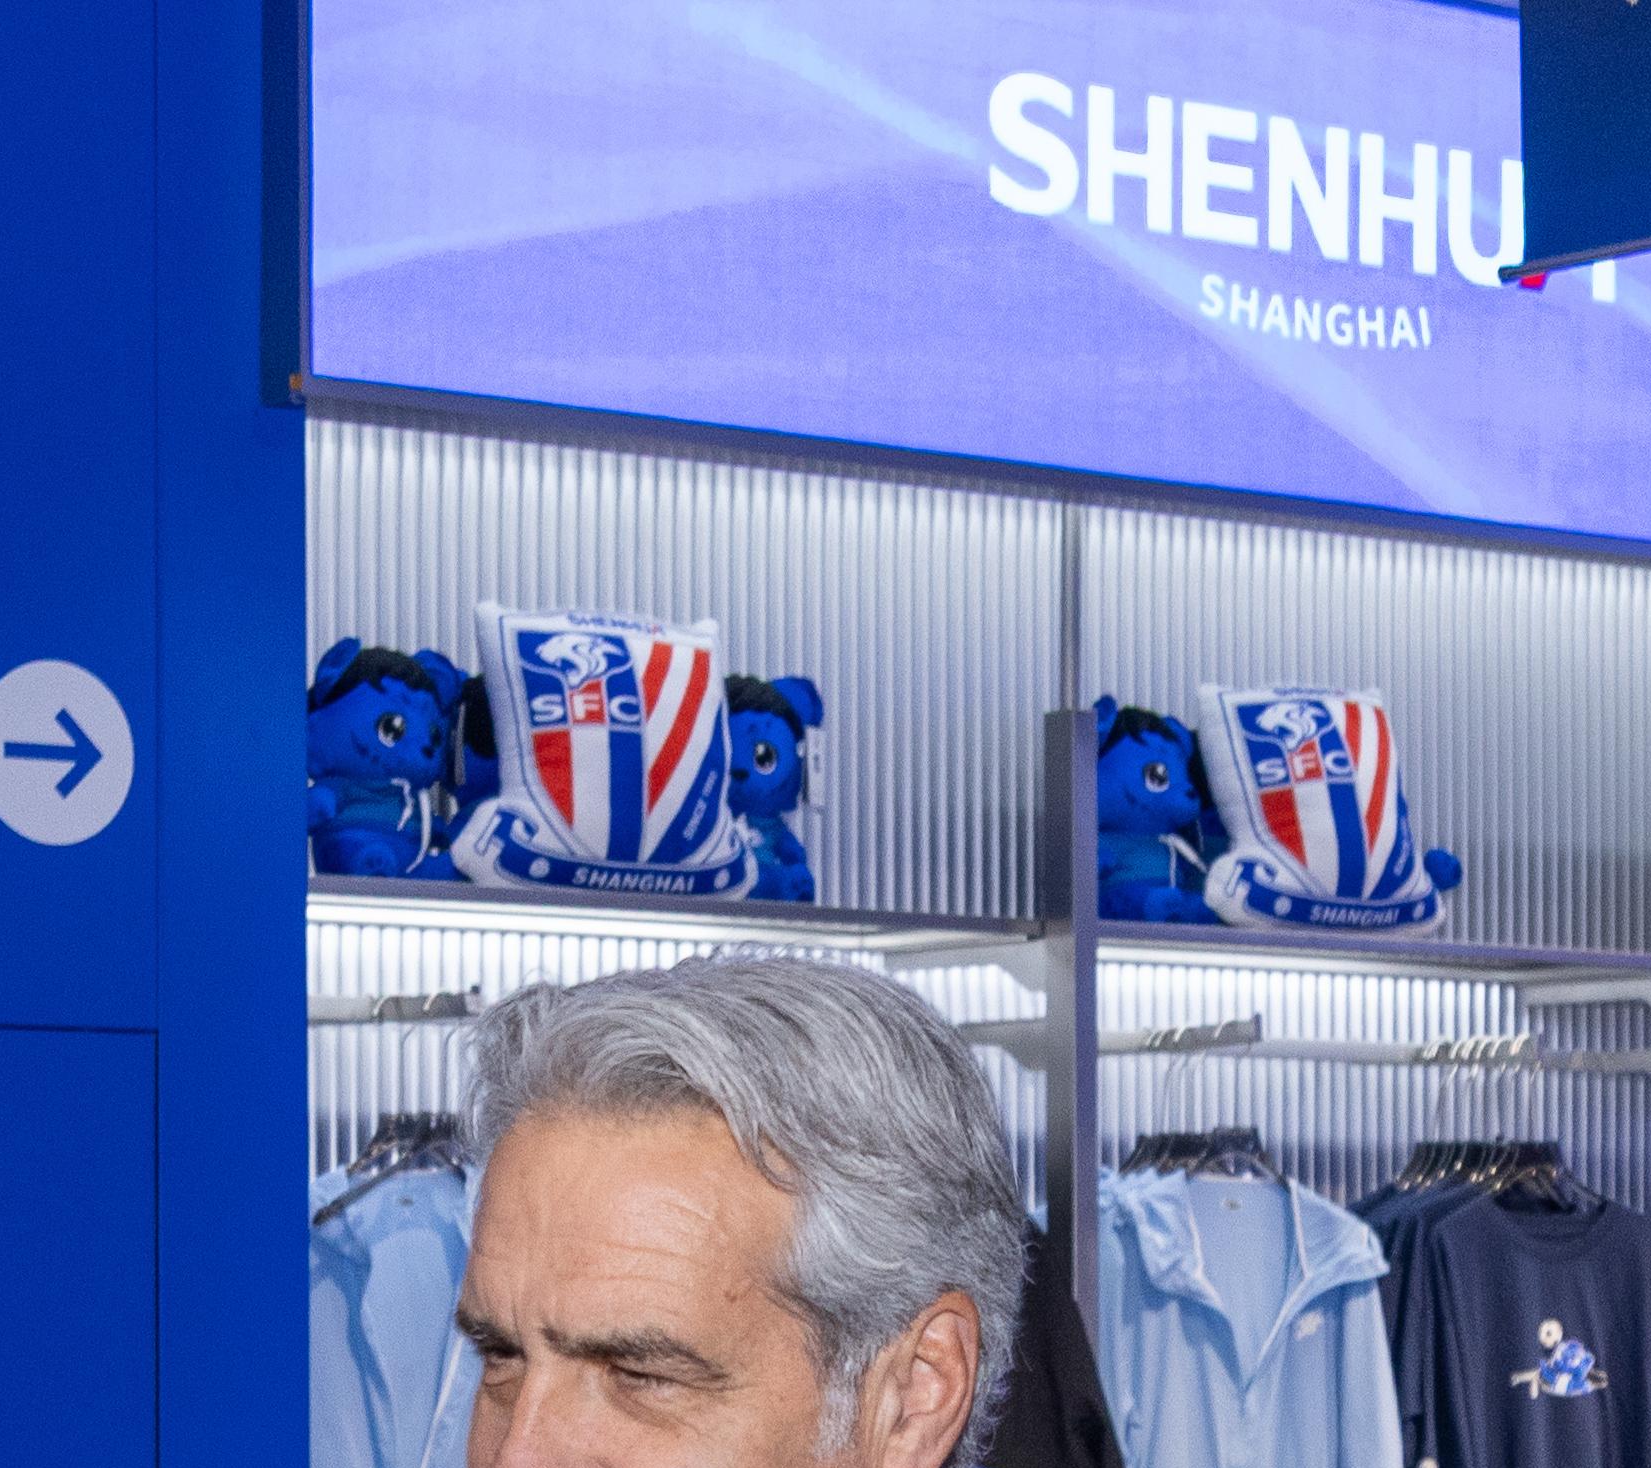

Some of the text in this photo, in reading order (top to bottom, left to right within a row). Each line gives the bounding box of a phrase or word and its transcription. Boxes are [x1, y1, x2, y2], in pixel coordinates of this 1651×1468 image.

[988, 72, 1617, 303] SHENHU
[1199, 272, 1433, 349] SHANGHAI
[530, 694, 642, 727] SFC
[1256, 749, 1354, 786] SFC
[572, 866, 696, 895] SHANGHAI
